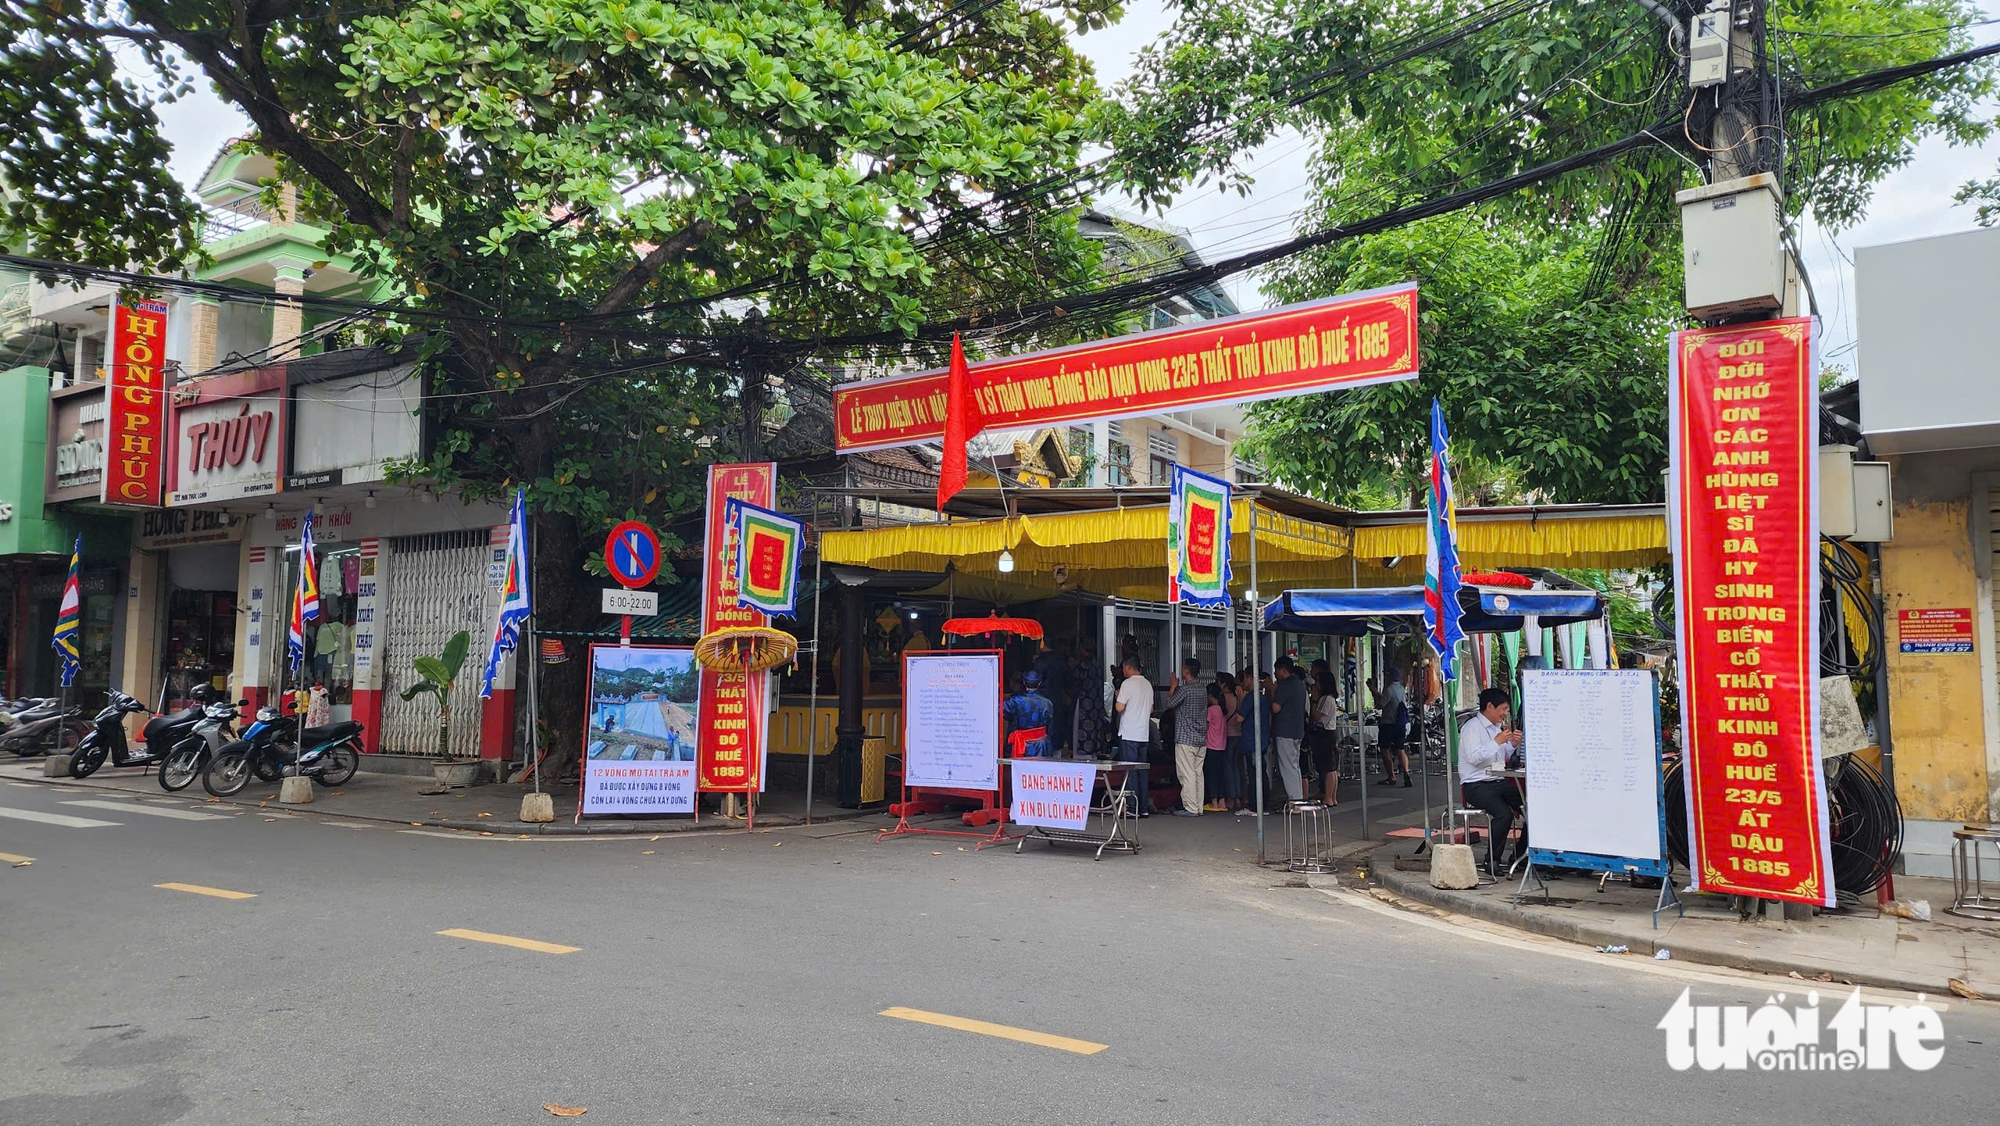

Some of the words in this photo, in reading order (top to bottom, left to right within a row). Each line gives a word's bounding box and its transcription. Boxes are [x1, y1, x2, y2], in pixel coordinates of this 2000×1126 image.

[1718, 340, 1764, 358] ĐỜI
[126, 314, 158, 405] HỒNG
[850, 397, 863, 434] LỄ
[862, 402, 885, 432] TRUY
[887, 395, 912, 433] NIỆM
[911, 398, 930, 425] 141
[995, 376, 1025, 418] TRẬN
[1023, 376, 1053, 409] VONG
[1054, 365, 1083, 405] ĐỒNG
[1086, 363, 1109, 401] BÀO
[1109, 363, 1137, 403] NẠN
[1136, 357, 1170, 394] VONG
[1171, 353, 1200, 389] 23/5
[1200, 336, 1232, 384] THẤT
[1234, 331, 1260, 379] THỦ
[1263, 336, 1296, 374] KINH
[1298, 325, 1318, 370] ĐÔ
[1321, 316, 1350, 366] HUẾ
[1353, 321, 1390, 361] 1885
[1718, 361, 1764, 380] ĐỜI
[1713, 382, 1771, 401] NHỚ
[1721, 406, 1760, 422] ƠN
[187, 403, 273, 473] THÚY
[1713, 426, 1769, 444] CÁC
[120, 412, 153, 500] PHÚC
[1712, 450, 1769, 466] ANH
[1705, 470, 1779, 489] HÙNG
[1714, 492, 1769, 512] LIỆT
[1726, 514, 1754, 532] SĨ
[1723, 536, 1759, 554] ĐÃ
[1725, 561, 1758, 576] HY
[1714, 583, 1774, 599] SINH
[610, 596, 652, 610] 6:00-22:00
[715, 608, 752, 621] ĐỒNG
[1703, 606, 1786, 623] TRONG
[1717, 624, 1773, 644] BIẾN
[1730, 646, 1761, 666] CỐ
[1716, 669, 1777, 689] THẤT
[717, 701, 743, 714] THỦ
[1723, 694, 1770, 712] THỦ
[714, 719, 746, 730] KINH
[1717, 719, 1779, 736] KINH
[719, 733, 738, 746] ĐÔ
[715, 747, 743, 761] HUẾ
[1732, 741, 1768, 758] ĐÔ
[593, 768, 603, 777] 12
[676, 769, 690, 777] AM
[713, 766, 744, 777] 1885
[1725, 763, 1778, 782] HUẾ
[1021, 774, 1045, 791] ĐANG
[1047, 772, 1071, 792] HÀNH
[1073, 771, 1084, 793] LỄ
[1724, 788, 1782, 805] 23/5
[1019, 801, 1036, 817] XIN
[1037, 802, 1046, 818] ĐI
[1048, 797, 1062, 819] LỐI
[1738, 808, 1772, 828] ẤT
[1730, 833, 1784, 853] DẬU
[1728, 856, 1791, 877] 1885
